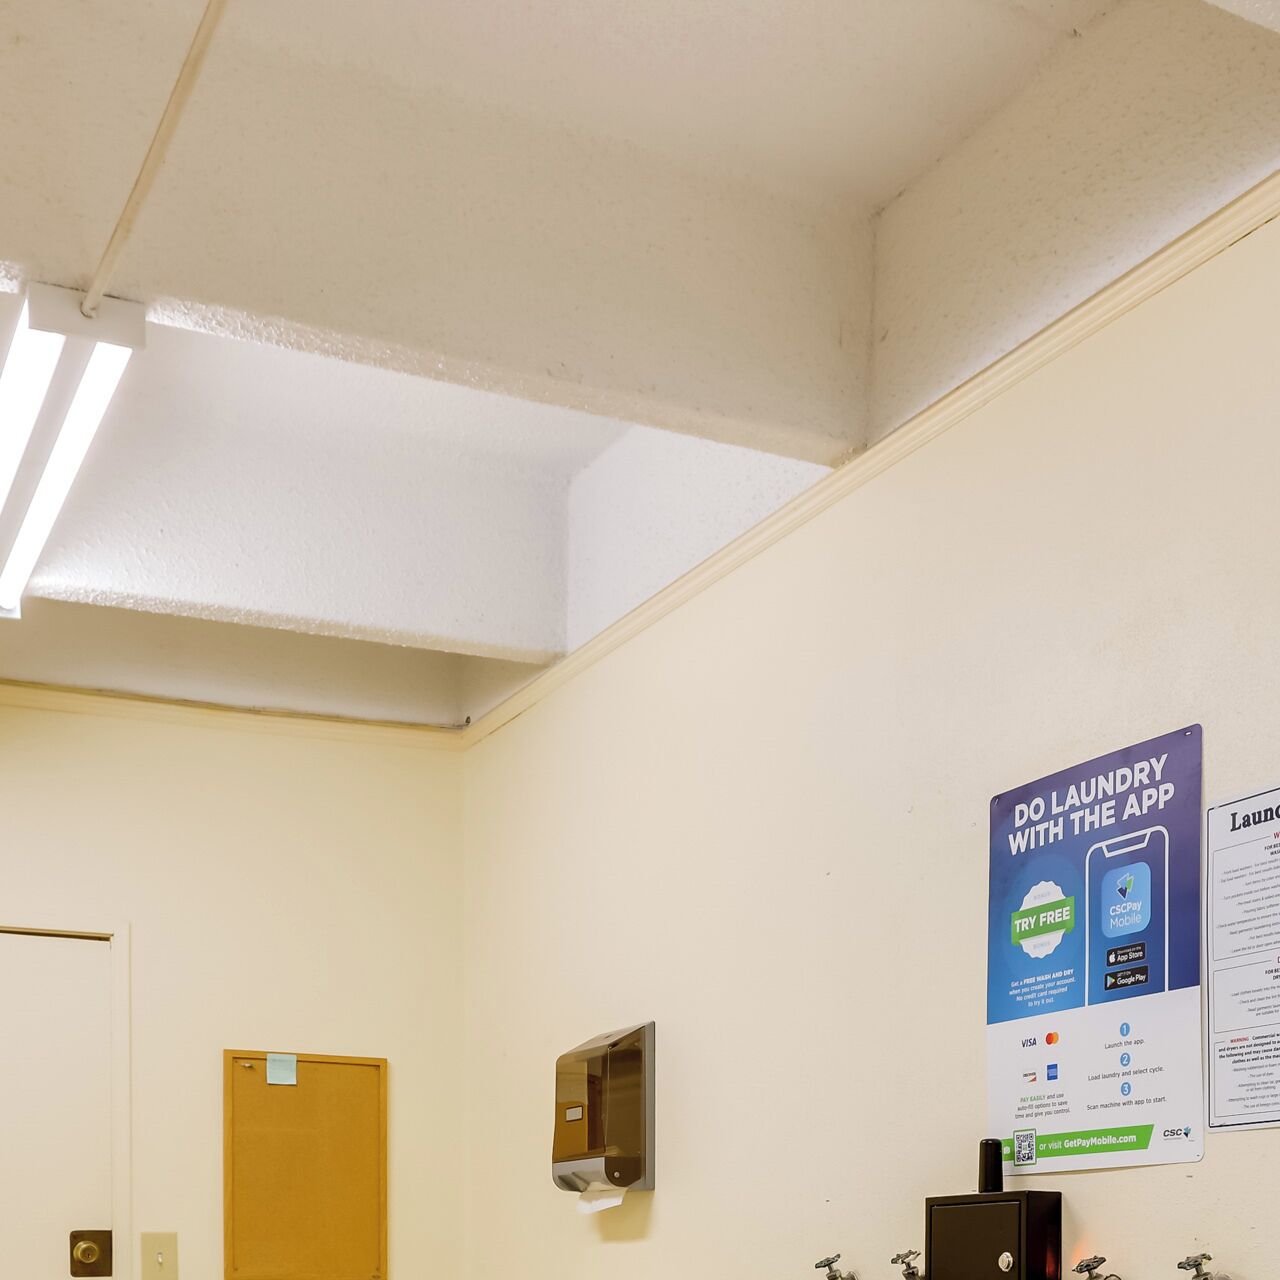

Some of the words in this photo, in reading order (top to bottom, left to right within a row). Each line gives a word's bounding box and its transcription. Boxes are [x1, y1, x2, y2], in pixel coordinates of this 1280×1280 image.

[1014, 797, 1045, 828] DO
[1051, 753, 1168, 816] LAUNDRY
[1008, 816, 1064, 856] WITH
[1070, 799, 1116, 836] THE
[1122, 782, 1175, 821] APP
[1109, 900, 1142, 916] CSCPay
[1014, 915, 1037, 933] TRY
[1039, 906, 1071, 925] FREE
[1110, 913, 1142, 929] Mobile
[1117, 954, 1129, 962] App
[1129, 951, 1144, 960] Store
[1116, 975, 1136, 985] Google
[1136, 974, 1147, 982] Play
[1122, 1024, 1127, 1035] 1
[1021, 1038, 1037, 1048] VISA
[1104, 1041, 1123, 1049] Launch
[1122, 1054, 1128, 1064] 2
[1122, 1084, 1129, 1094] 3
[1163, 1128, 1182, 1138] CSC
[1039, 1142, 1047, 1150] or
[1048, 1140, 1063, 1149] visit
[1064, 1134, 1136, 1149] GetPayMobile.com
